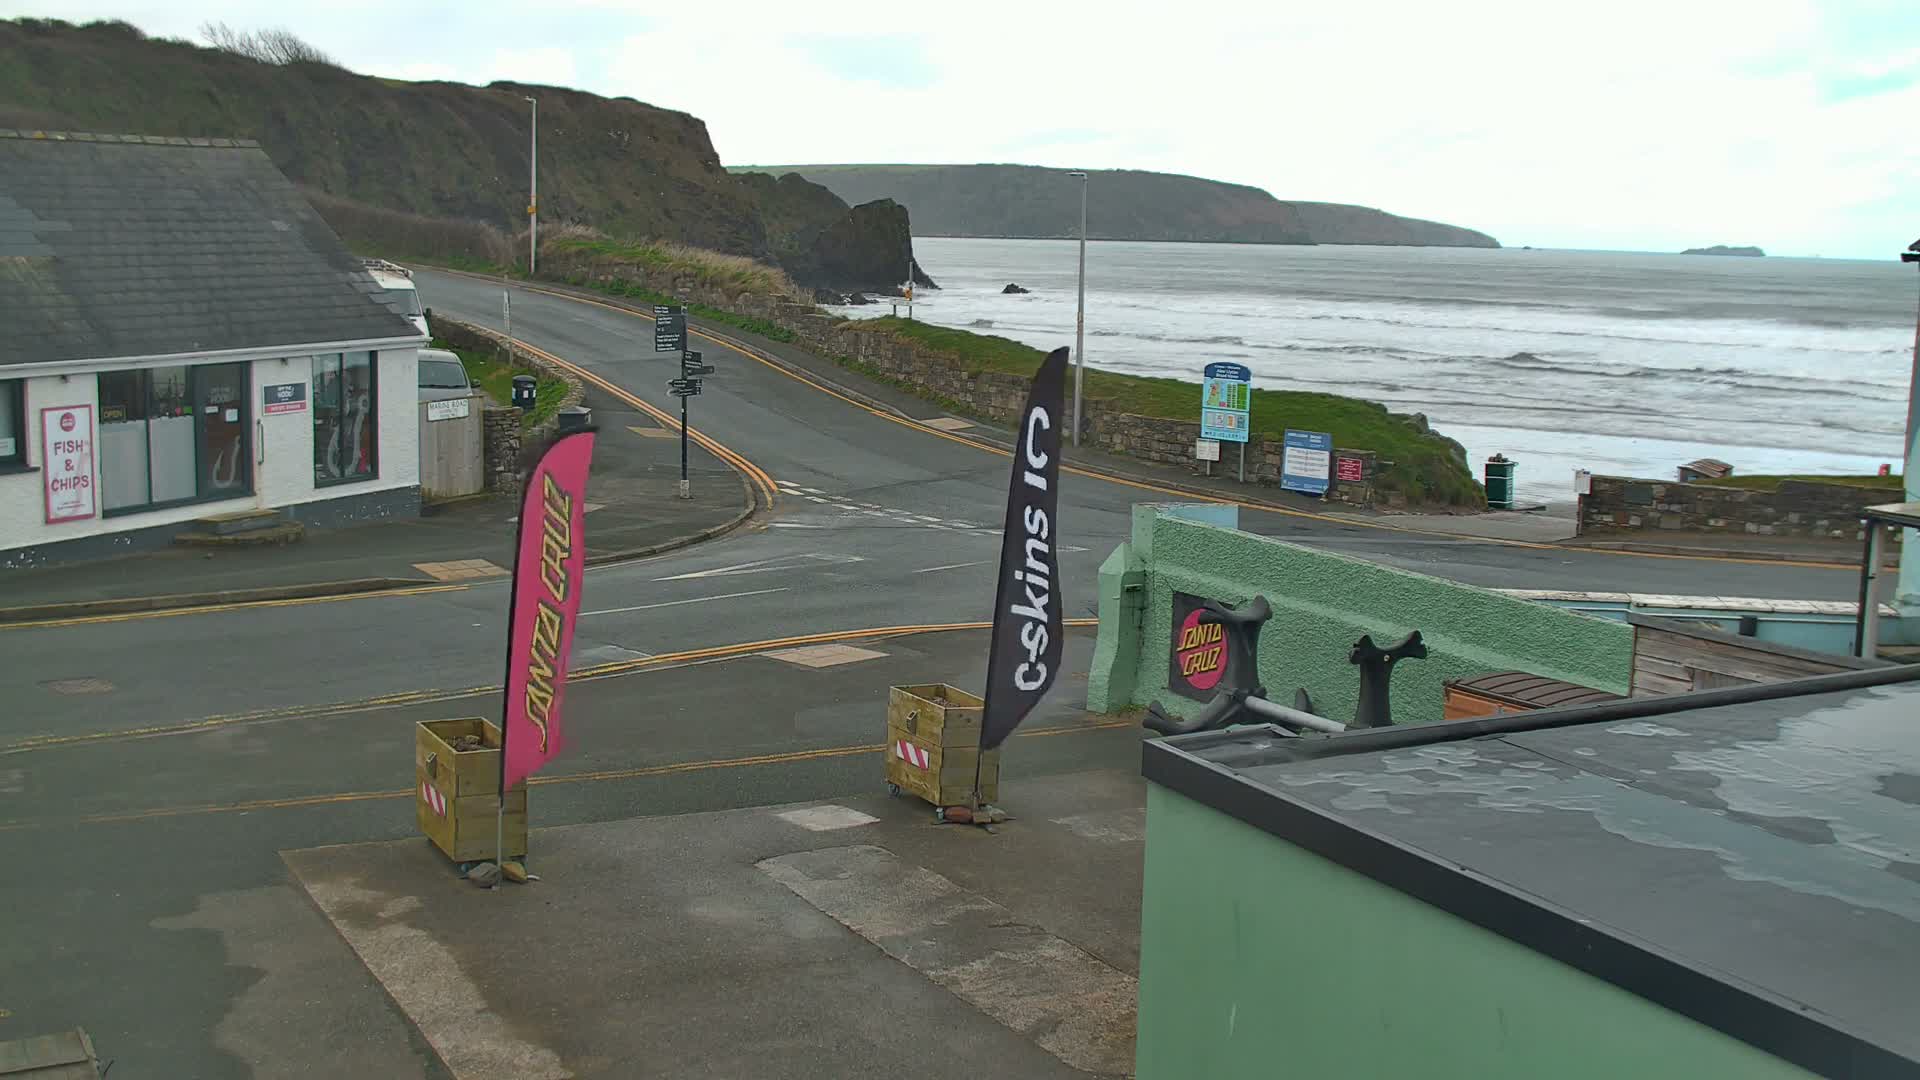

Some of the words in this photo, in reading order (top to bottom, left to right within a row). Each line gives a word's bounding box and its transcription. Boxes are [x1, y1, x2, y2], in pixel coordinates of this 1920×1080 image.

[54, 440, 84, 456] FISH
[64, 459, 74, 472] &
[51, 475, 90, 492] CHIPS
[539, 472, 572, 603] CRUZ
[1176, 623, 1223, 652] SANTA
[1182, 646, 1221, 677] CRUZ
[524, 601, 565, 754] SANTA
